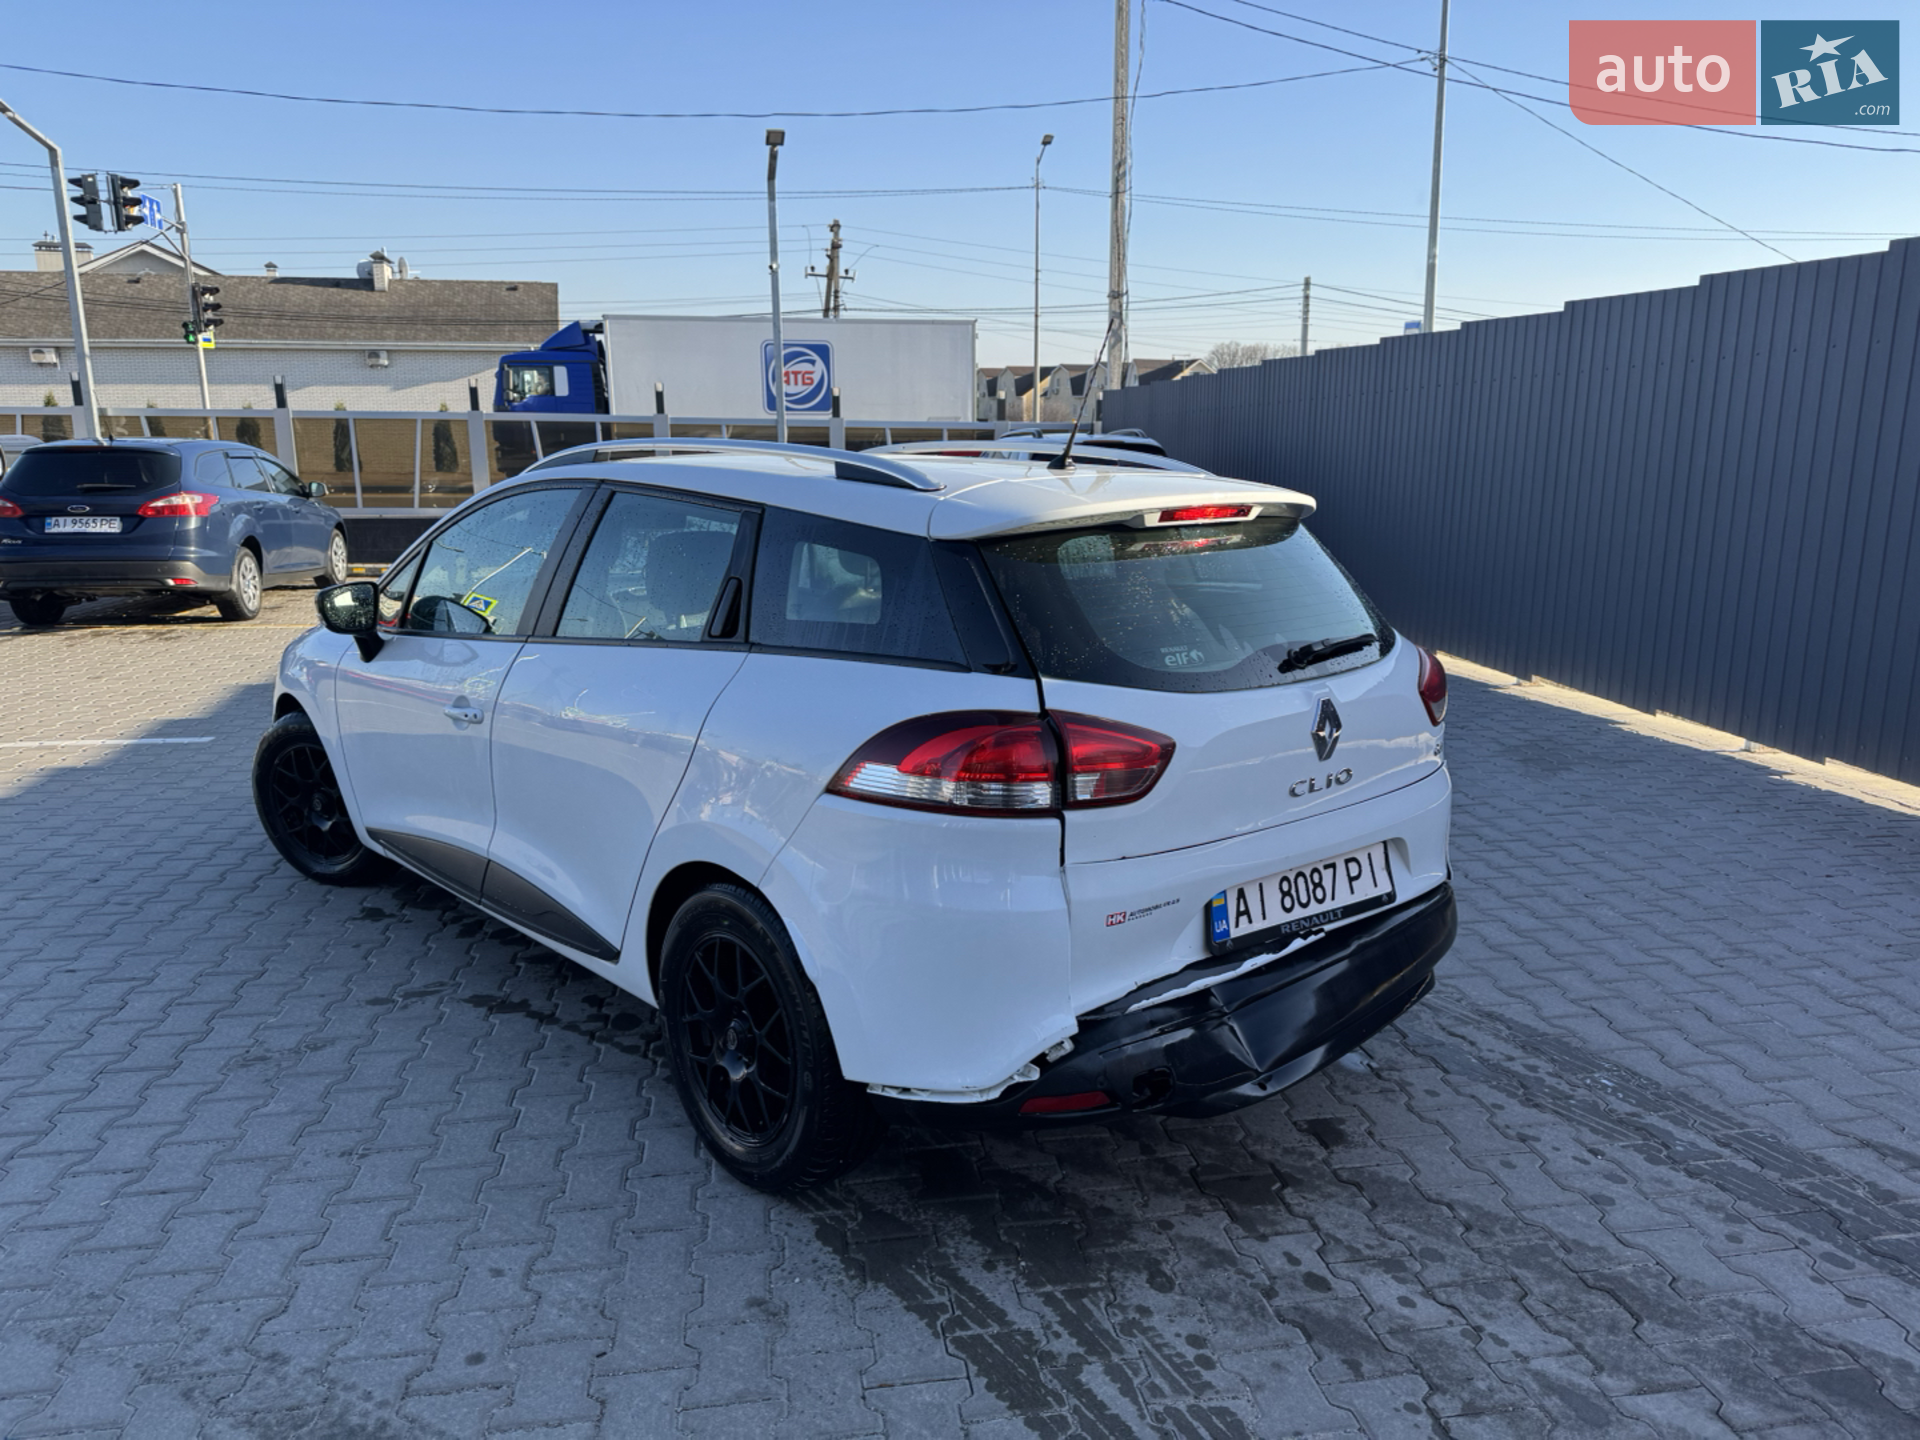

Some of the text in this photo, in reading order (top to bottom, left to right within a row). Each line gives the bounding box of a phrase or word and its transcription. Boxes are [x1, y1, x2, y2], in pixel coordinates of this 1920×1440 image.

[52, 518, 67, 529] AI
[70, 518, 98, 529] 9565
[100, 518, 118, 529] PE
[1164, 651, 1189, 666] elf
[1288, 767, 1353, 798] CLIO
[1234, 882, 1267, 929] AI
[1278, 861, 1337, 914] 8087
[1343, 851, 1378, 896] PI
[1214, 919, 1229, 933] UA
[1280, 908, 1344, 934] RENAULT
